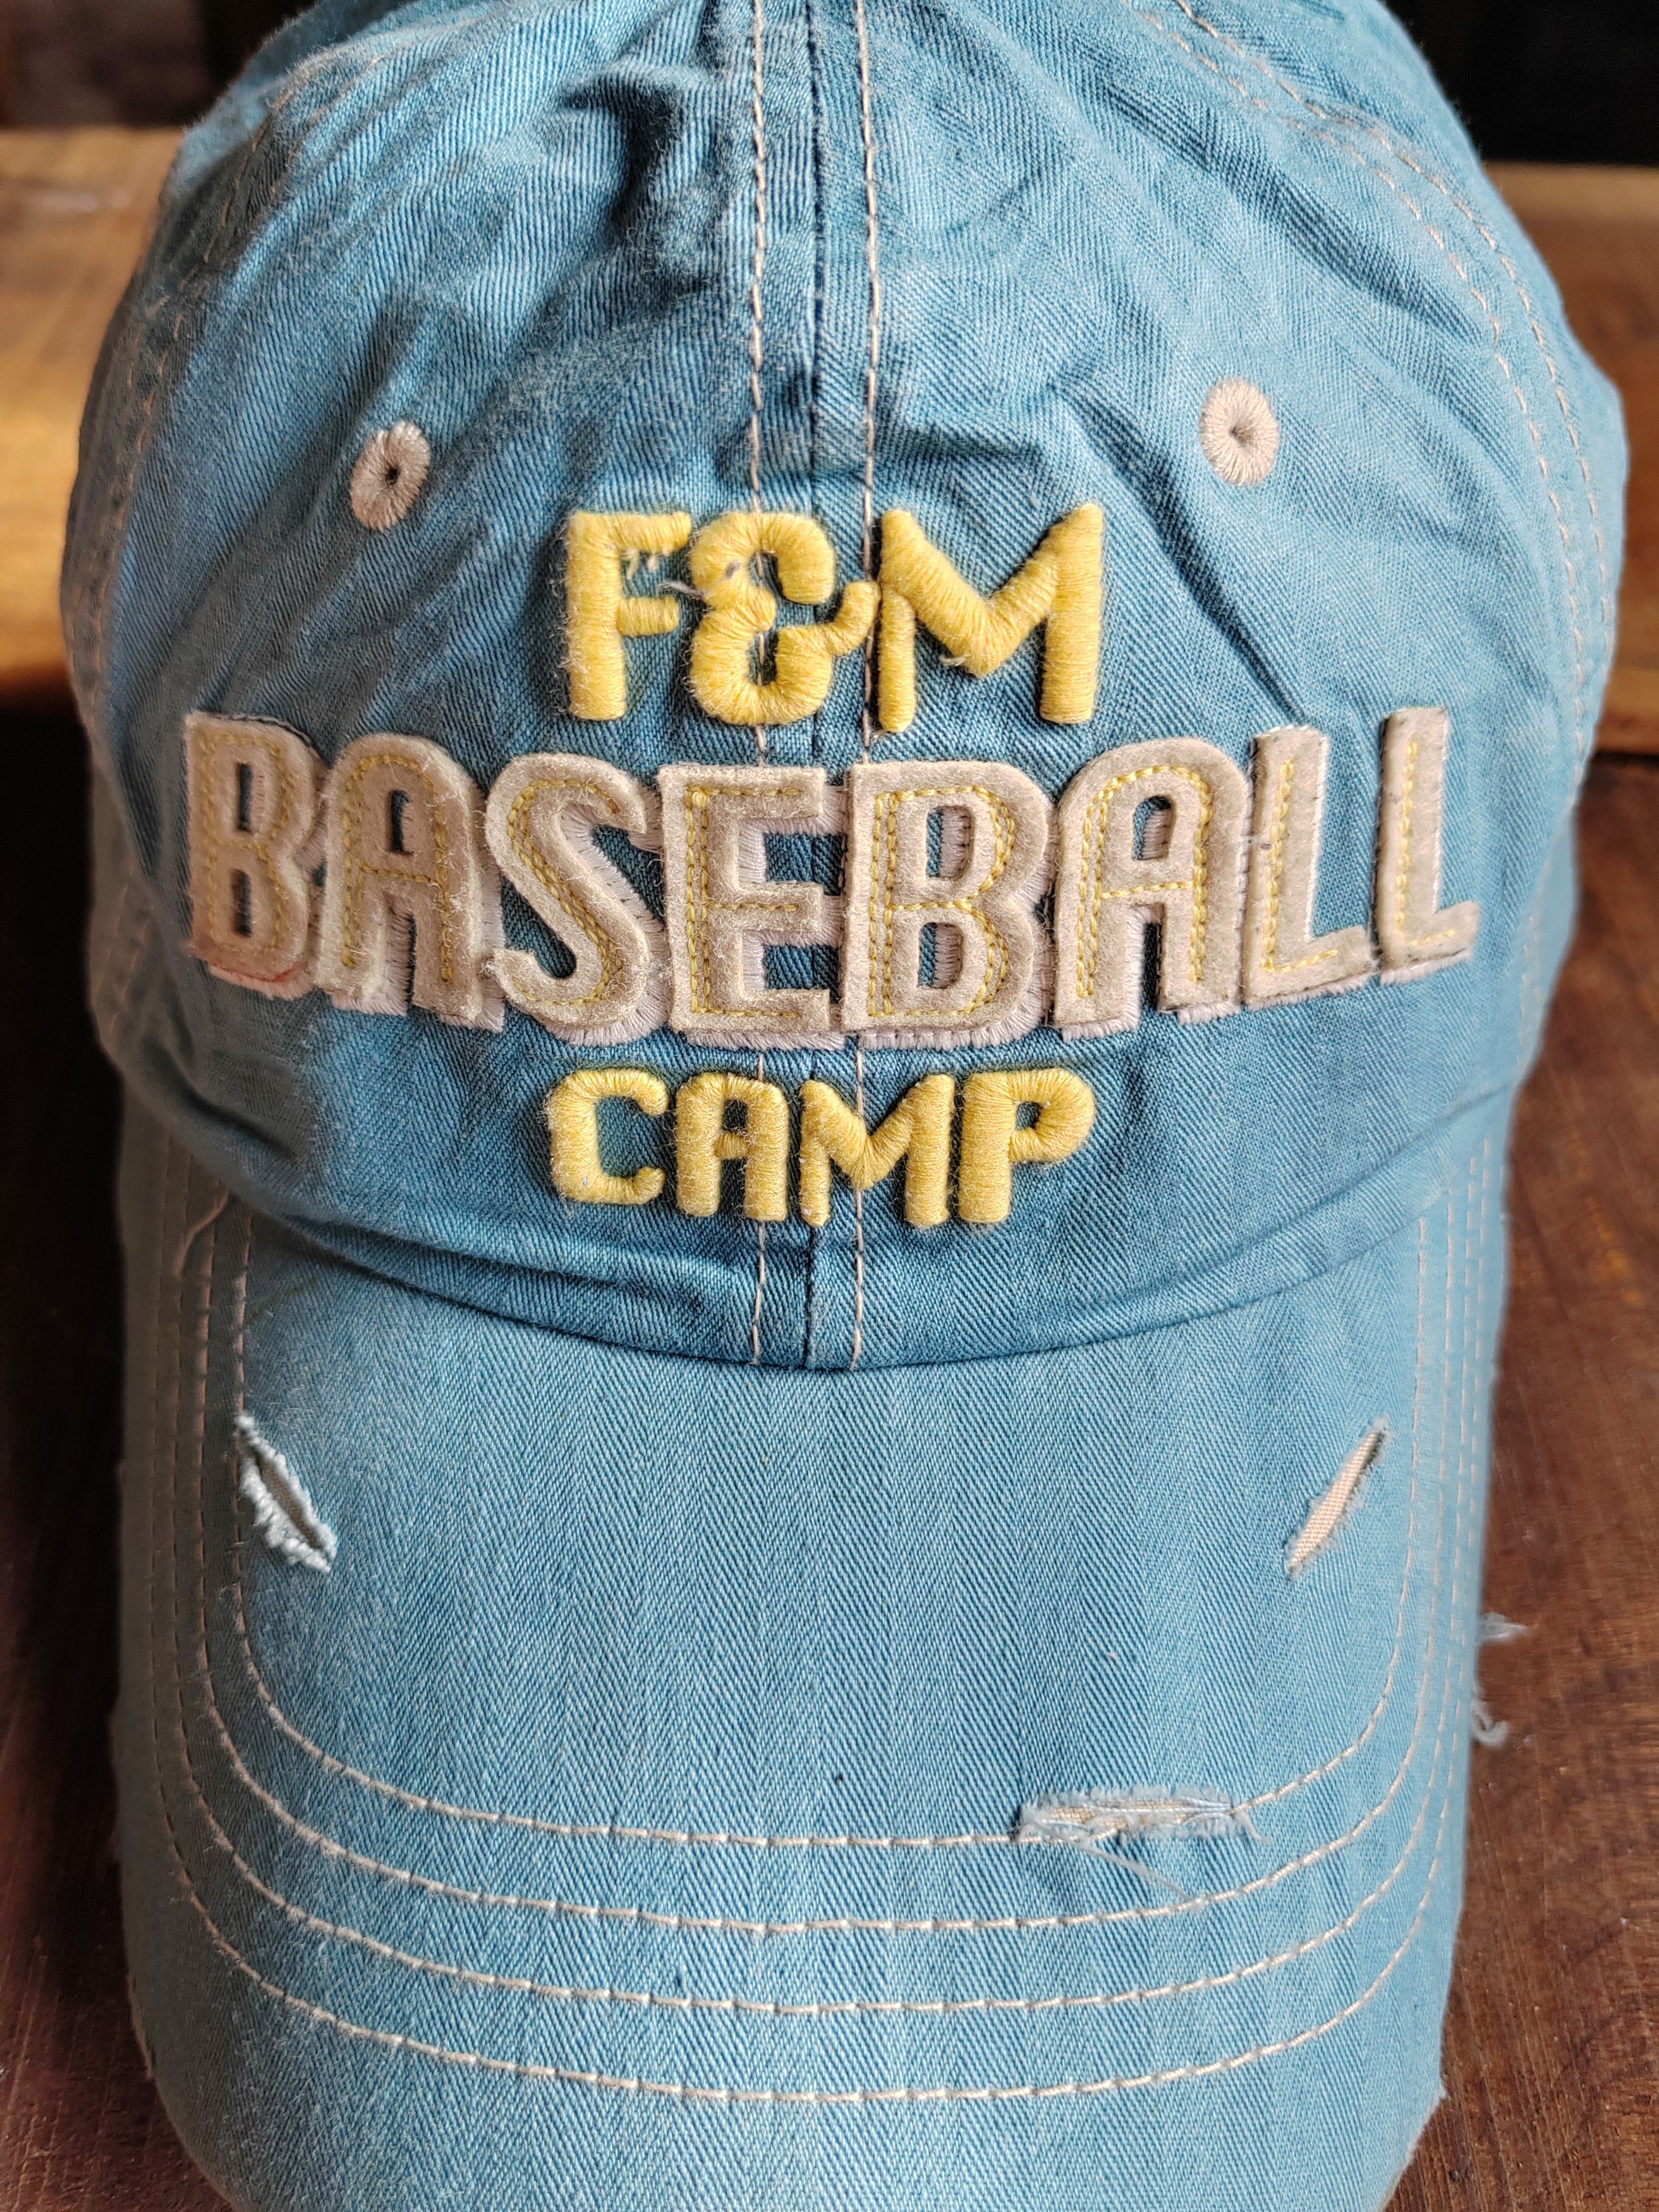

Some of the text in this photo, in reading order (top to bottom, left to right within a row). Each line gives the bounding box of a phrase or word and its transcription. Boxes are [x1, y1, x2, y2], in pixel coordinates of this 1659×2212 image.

[564, 501, 1103, 732] F&M
[184, 704, 1478, 1049] BASEBALL
[545, 1066, 1096, 1227] CAMP
